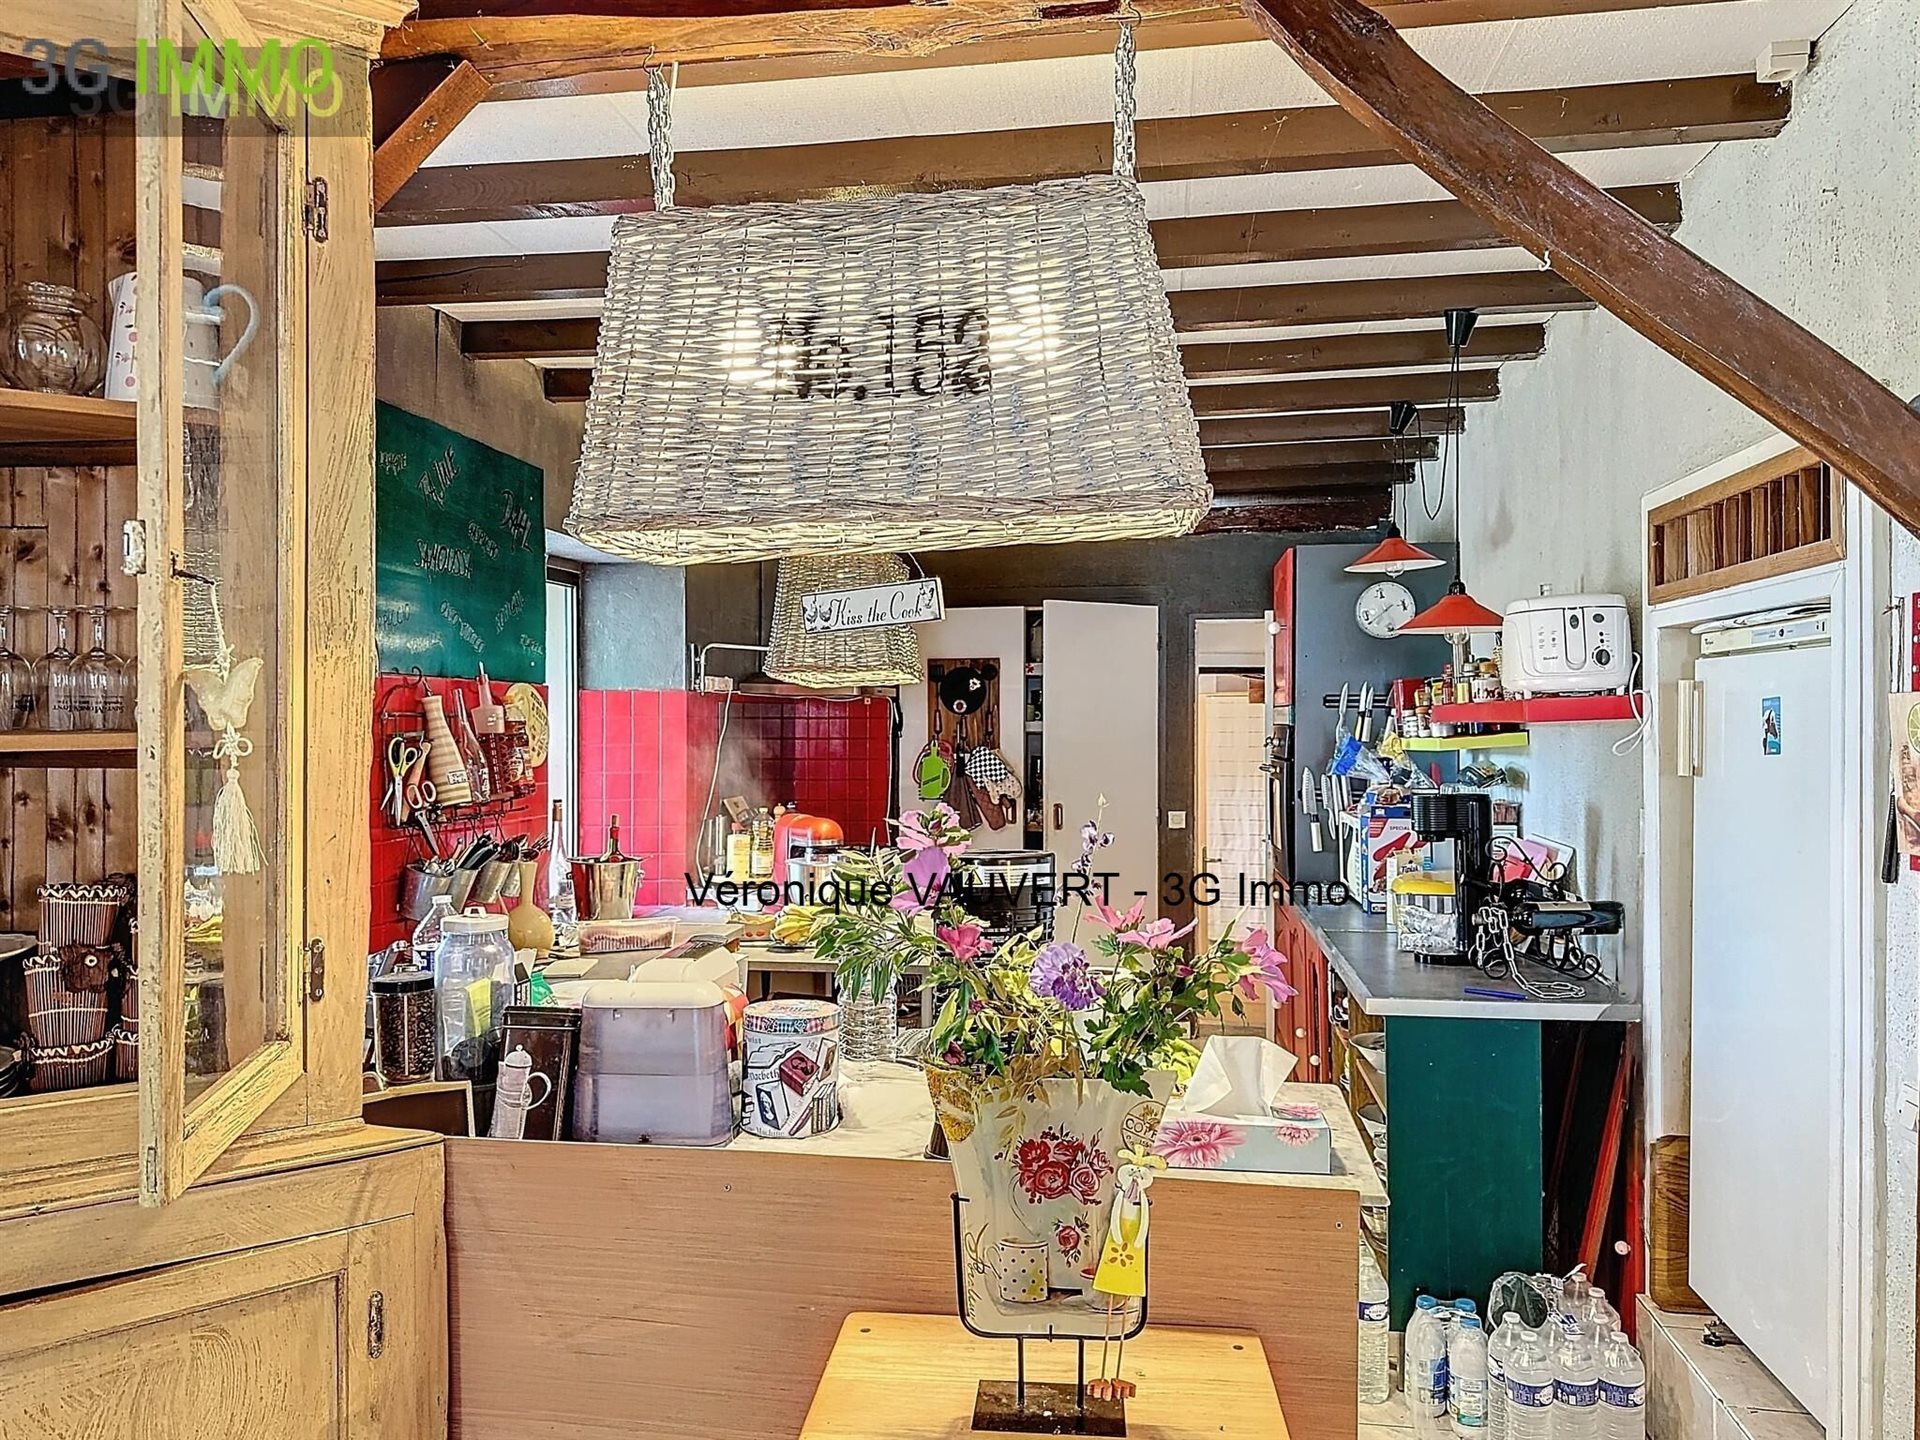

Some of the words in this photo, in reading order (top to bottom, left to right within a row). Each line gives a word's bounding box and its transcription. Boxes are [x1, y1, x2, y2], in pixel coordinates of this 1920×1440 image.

[830, 597, 863, 627] Kiss
[867, 598, 887, 623] the
[889, 590, 922, 621] Cook
